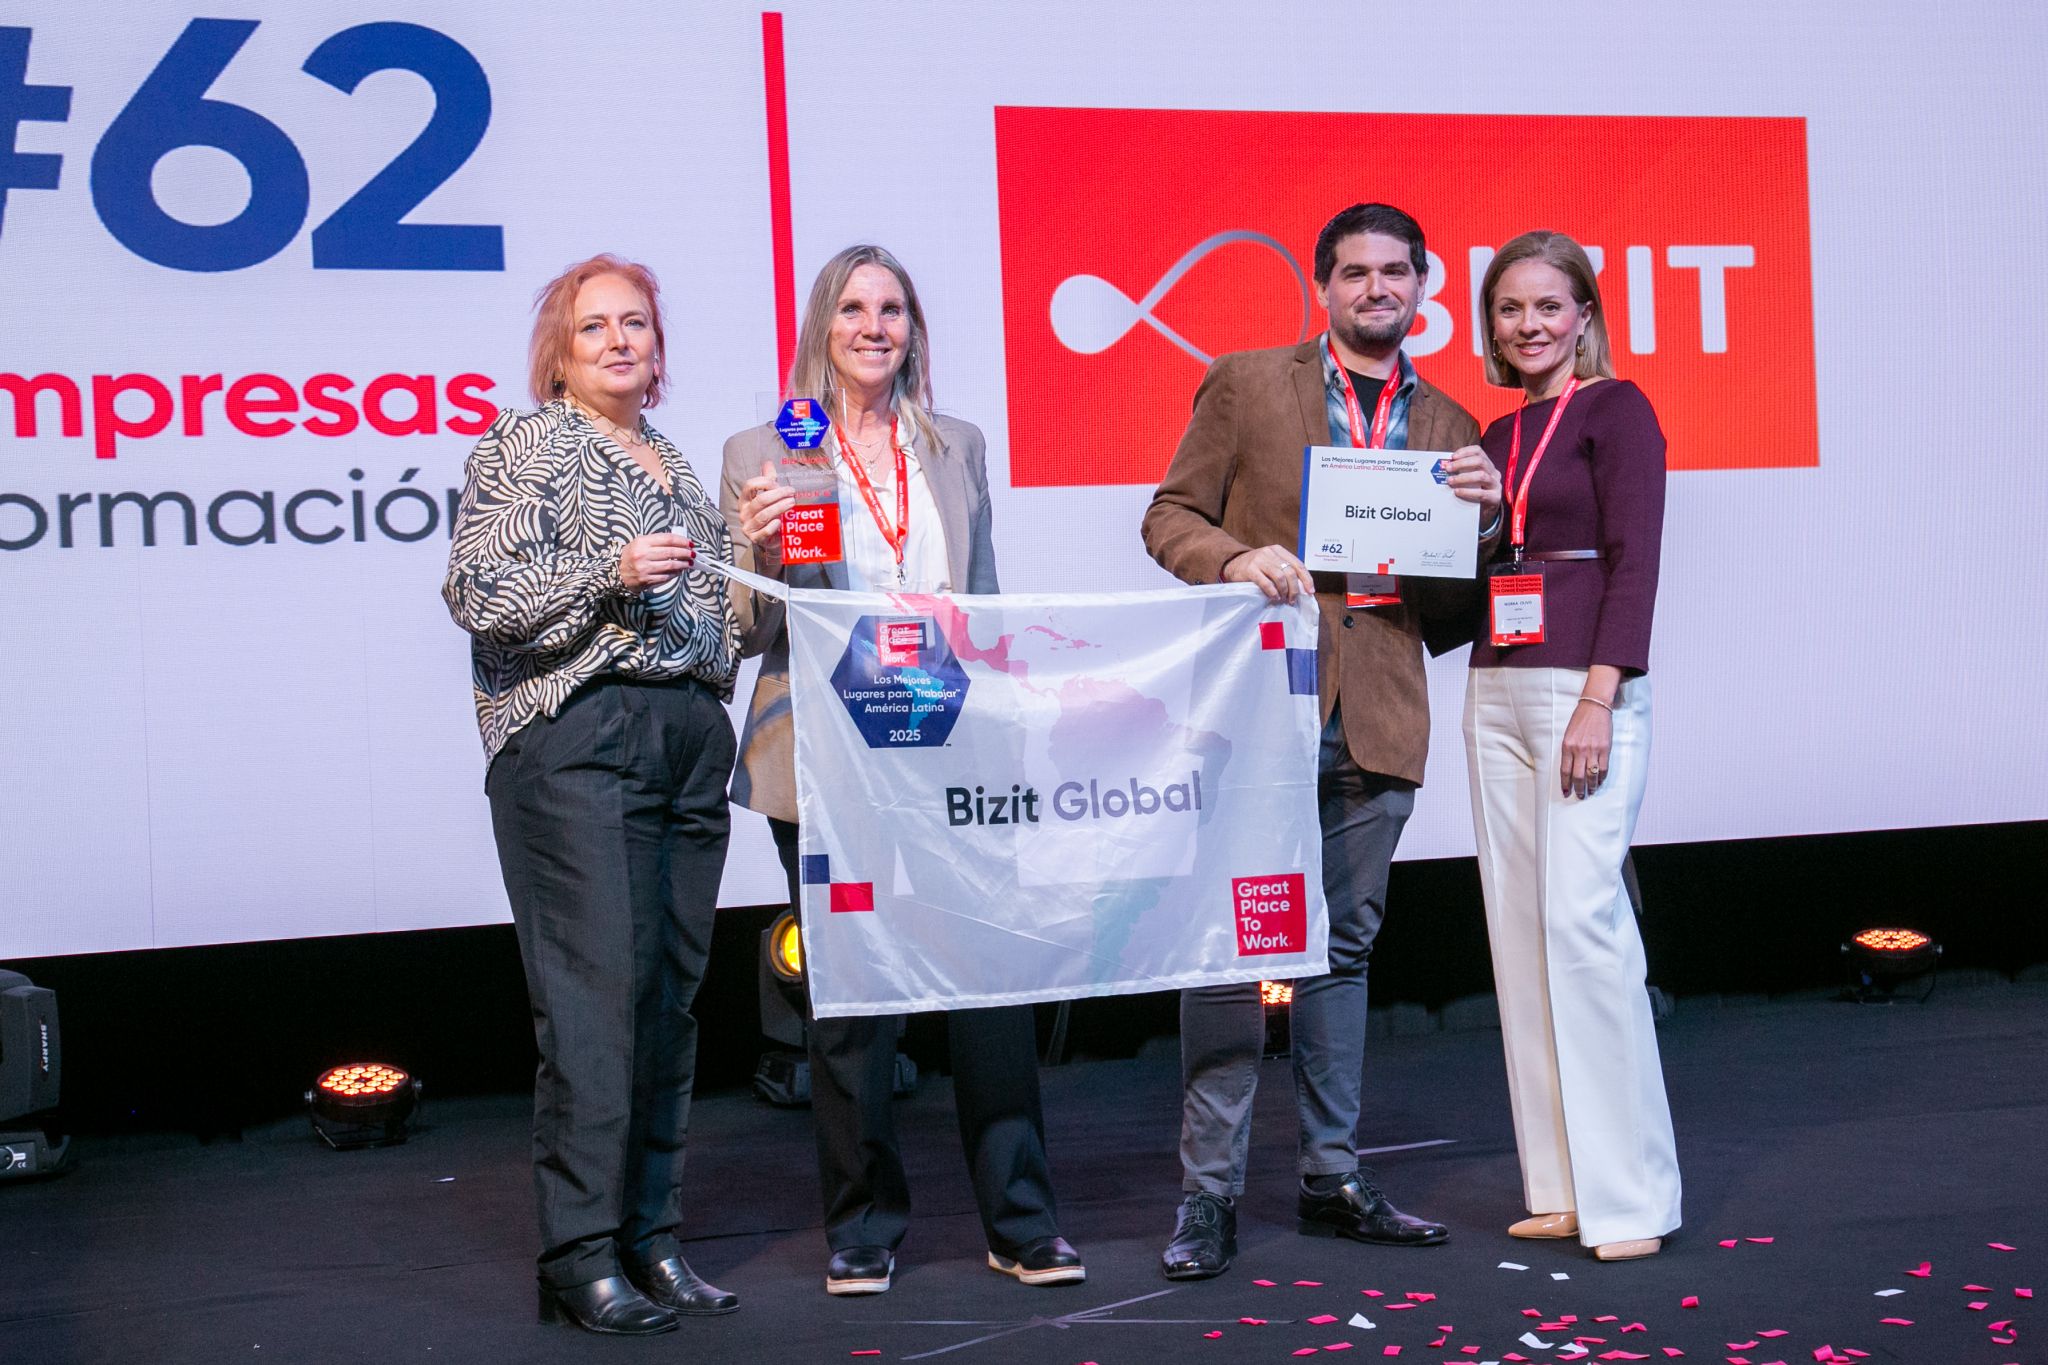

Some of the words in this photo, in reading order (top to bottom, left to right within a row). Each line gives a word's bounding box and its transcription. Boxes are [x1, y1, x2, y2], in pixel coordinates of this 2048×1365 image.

[784, 508, 824, 521] Great
[1345, 505, 1376, 519] Bizit
[1380, 506, 1431, 522] Global
[786, 522, 824, 534] Place
[786, 534, 802, 546] To
[1321, 544, 1343, 554] #62
[874, 675, 891, 684] Los
[894, 676, 932, 686] Mejores
[844, 690, 885, 700] Lugares
[888, 690, 913, 700] para
[865, 704, 909, 713] América
[912, 702, 944, 712] Latina
[889, 730, 921, 742] 2025
[946, 784, 1039, 826] Bizit
[1053, 770, 1202, 821] Global
[1237, 880, 1290, 898] Great
[1240, 898, 1290, 914] Place
[1240, 916, 1262, 932] To
